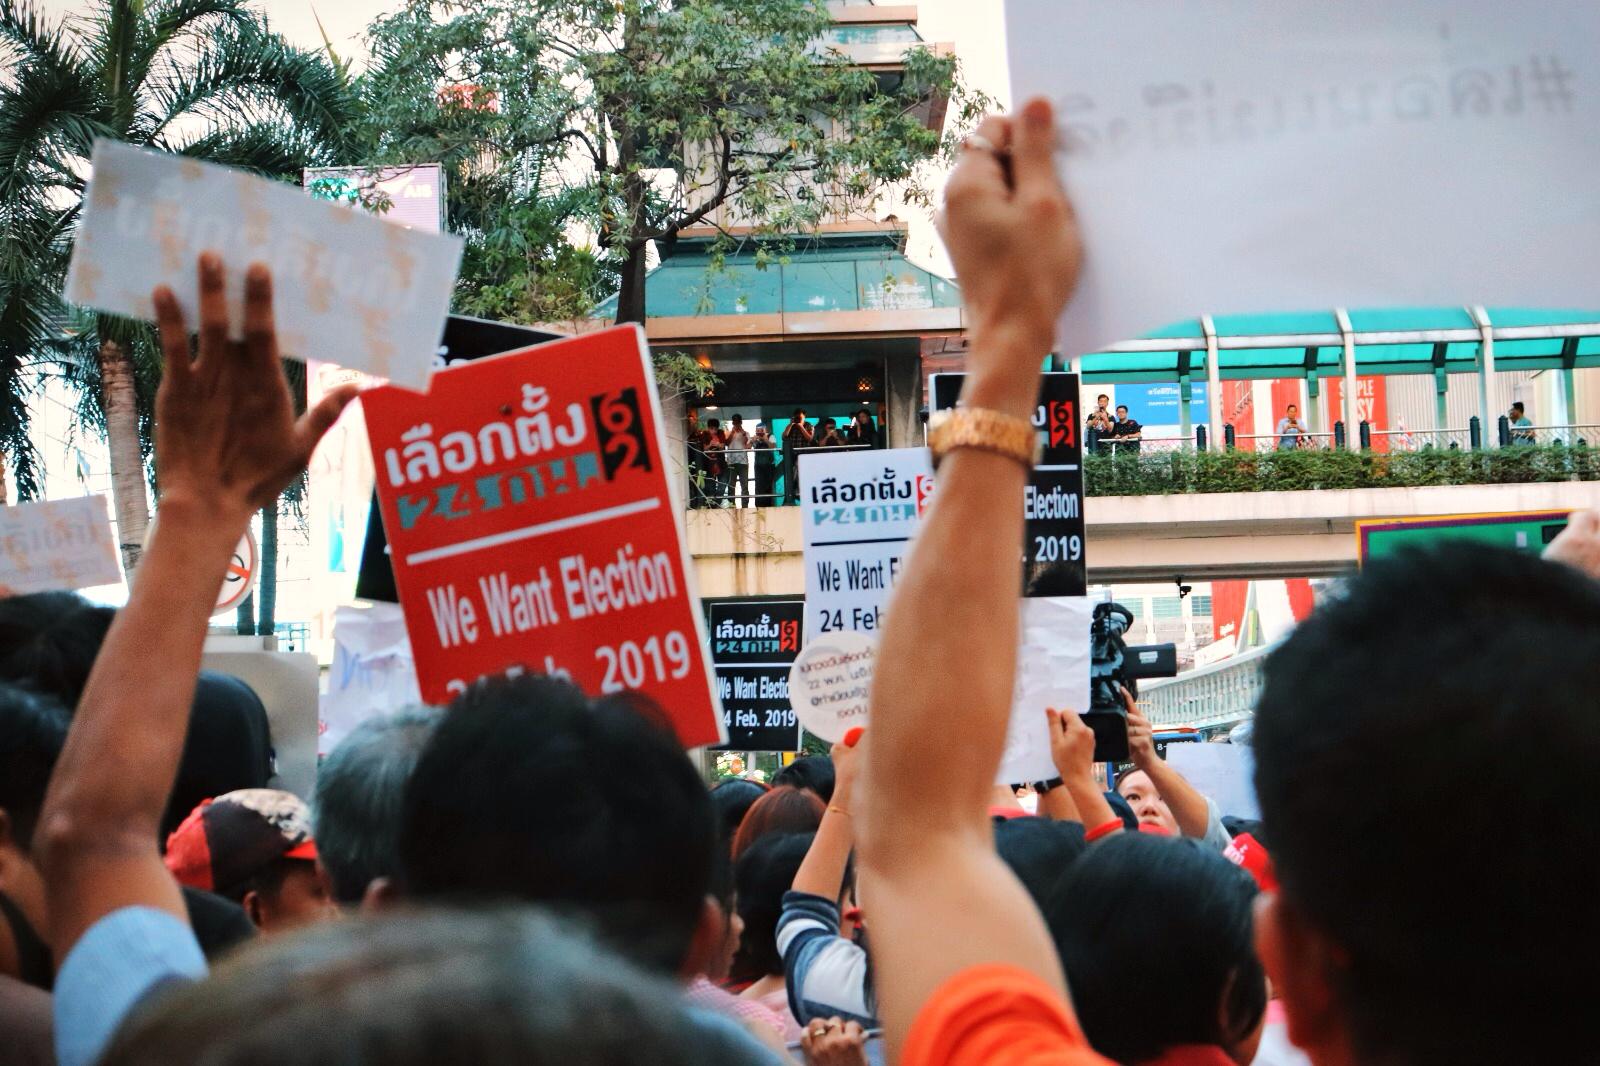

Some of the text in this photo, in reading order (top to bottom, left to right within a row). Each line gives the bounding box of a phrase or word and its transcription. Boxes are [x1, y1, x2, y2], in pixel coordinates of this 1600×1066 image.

[1339, 379, 1375, 397] SPLE
[385, 383, 586, 486] เลือกตั้ง
[811, 467, 912, 503] เลือกตั้ง
[1024, 485, 1079, 519] Election
[1035, 535, 1081, 562] 2019
[817, 561, 841, 592] We
[846, 559, 884, 590] Want
[426, 543, 677, 648] We Want Election
[716, 613, 779, 639] เลือกตั้ง
[820, 609, 844, 633] 24
[595, 631, 691, 694] 2019
[717, 675, 790, 699] We Want Electio
[723, 708, 796, 728] 4 Feb. 2019
